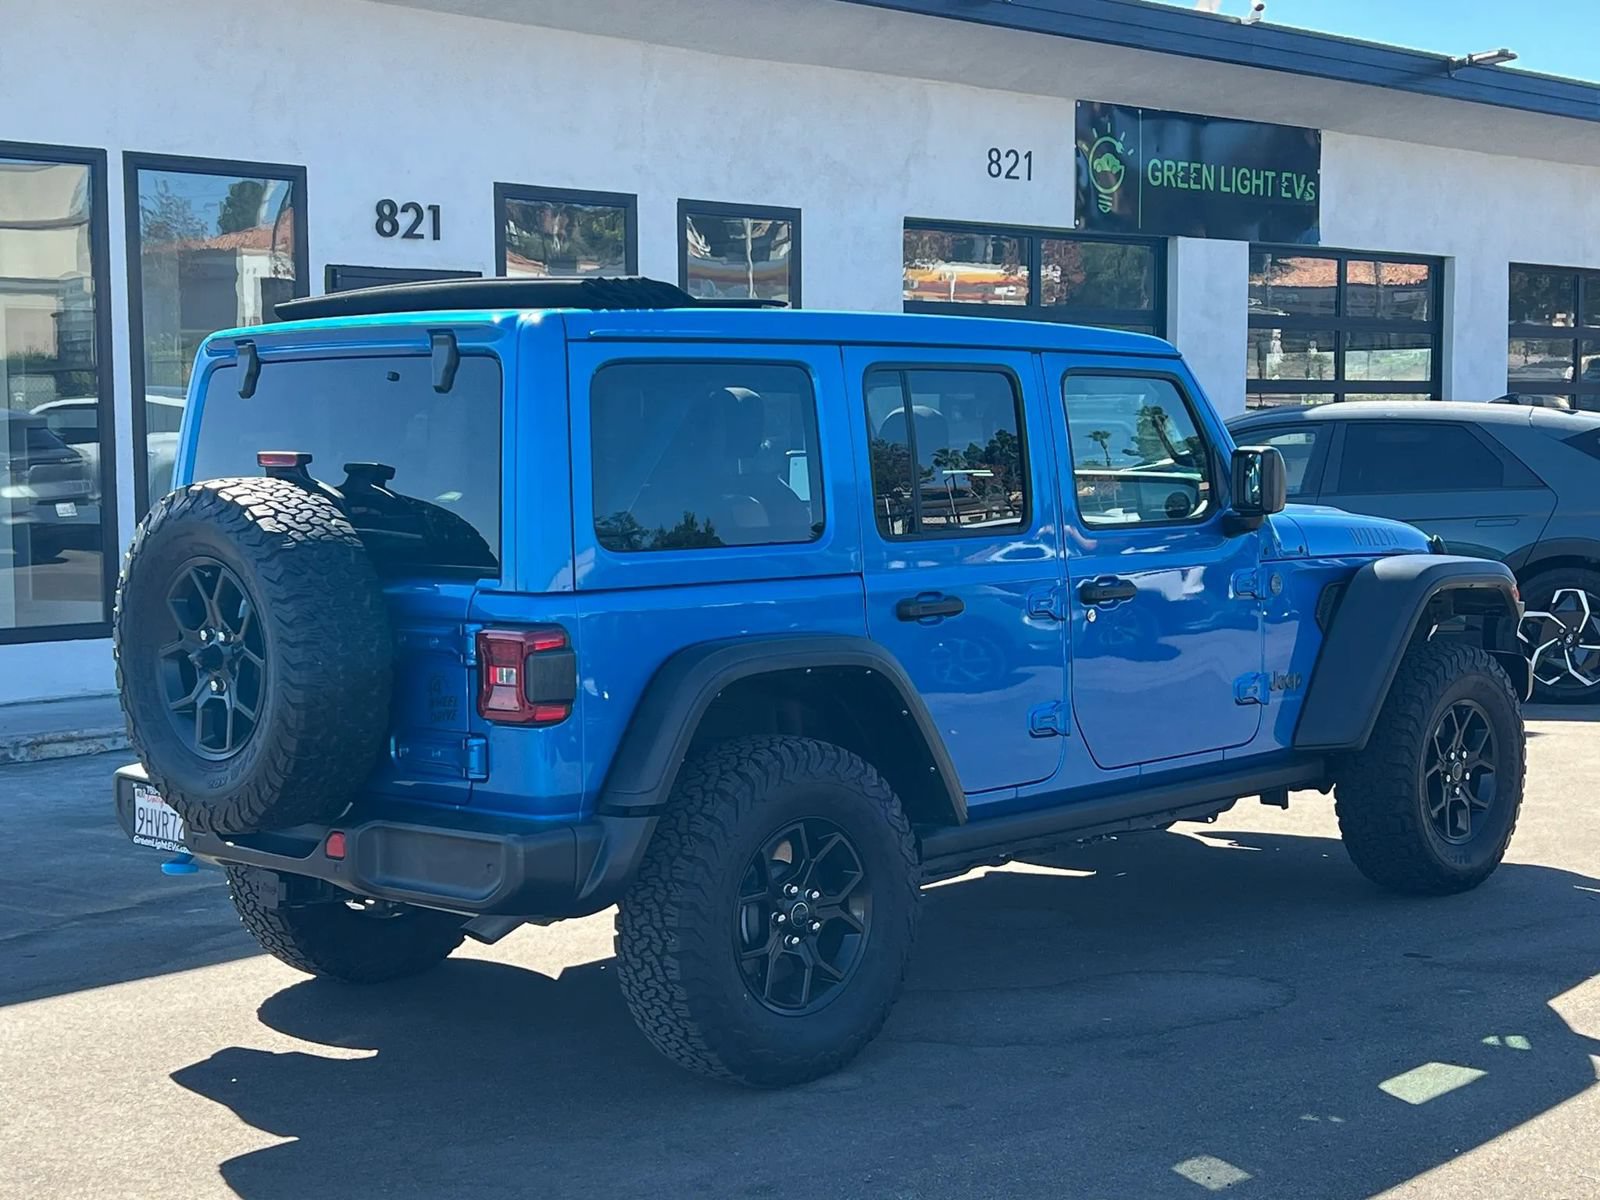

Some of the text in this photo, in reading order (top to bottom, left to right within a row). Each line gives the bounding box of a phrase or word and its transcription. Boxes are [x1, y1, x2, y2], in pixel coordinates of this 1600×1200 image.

[987, 147, 1032, 181] 821
[1147, 158, 1214, 191] GREEN
[1221, 165, 1276, 198] LIGHT
[375, 198, 441, 241] 821
